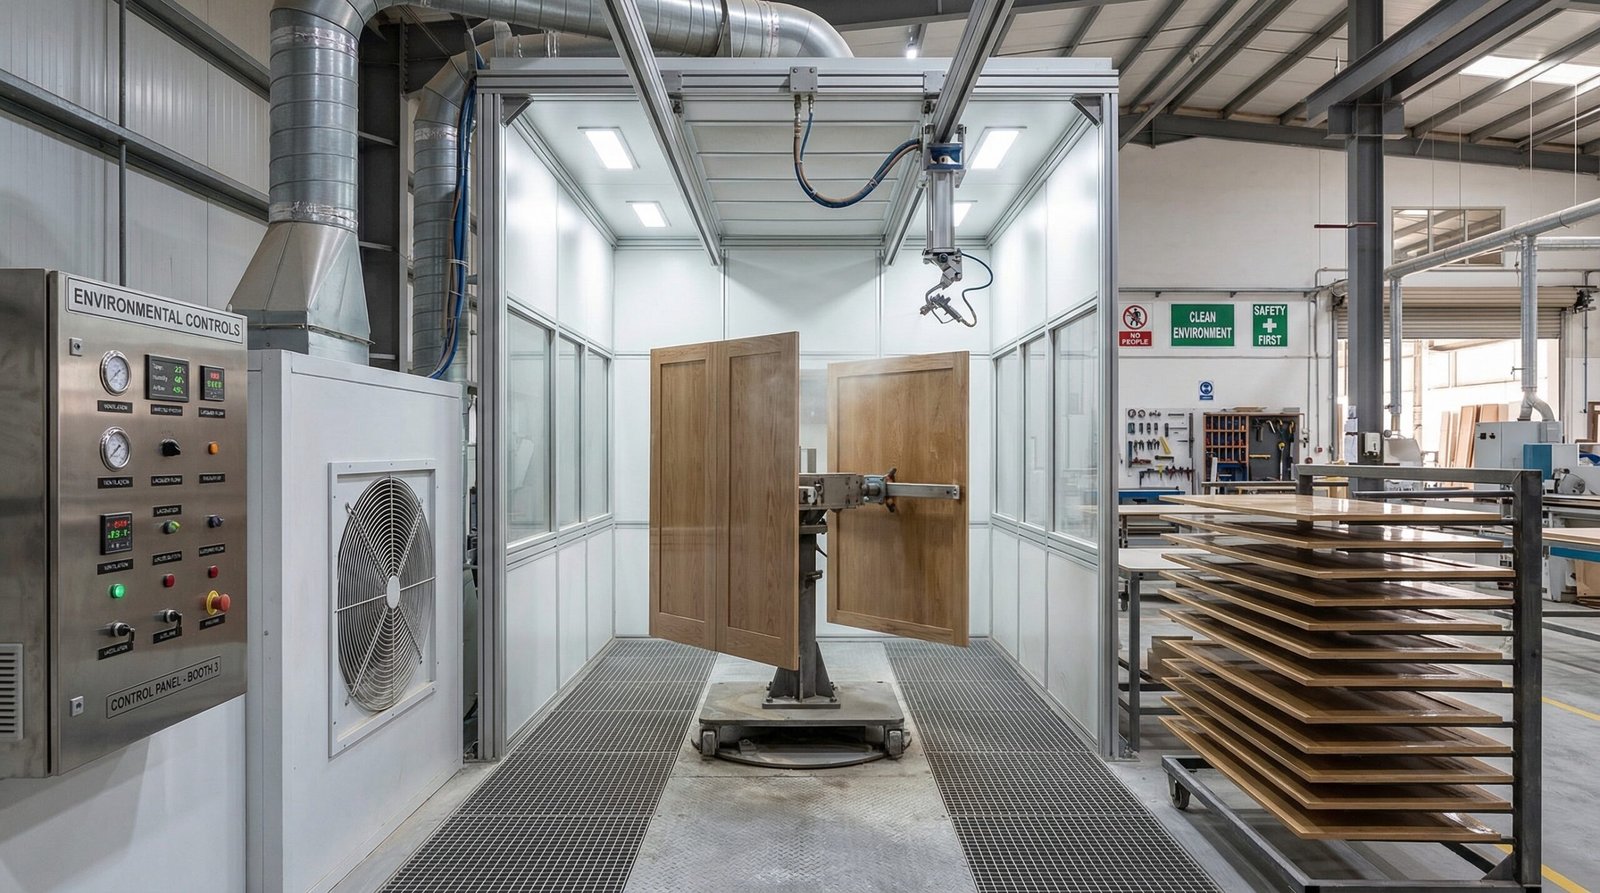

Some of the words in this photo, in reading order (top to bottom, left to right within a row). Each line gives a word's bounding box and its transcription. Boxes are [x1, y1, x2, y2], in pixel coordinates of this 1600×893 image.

[74, 287, 183, 325] ENVIRONMENTAL
[185, 313, 241, 337] CONTROLS
[1254, 305, 1286, 316] SAFETY
[1189, 311, 1216, 323] CLEAN
[1173, 327, 1232, 339] ENVIRONMENT
[1258, 335, 1282, 346] FIRST
[111, 687, 153, 711] CONTROL
[156, 676, 182, 695] PANEL
[187, 664, 213, 683] BOOTH
[214, 661, 219, 673] 3
